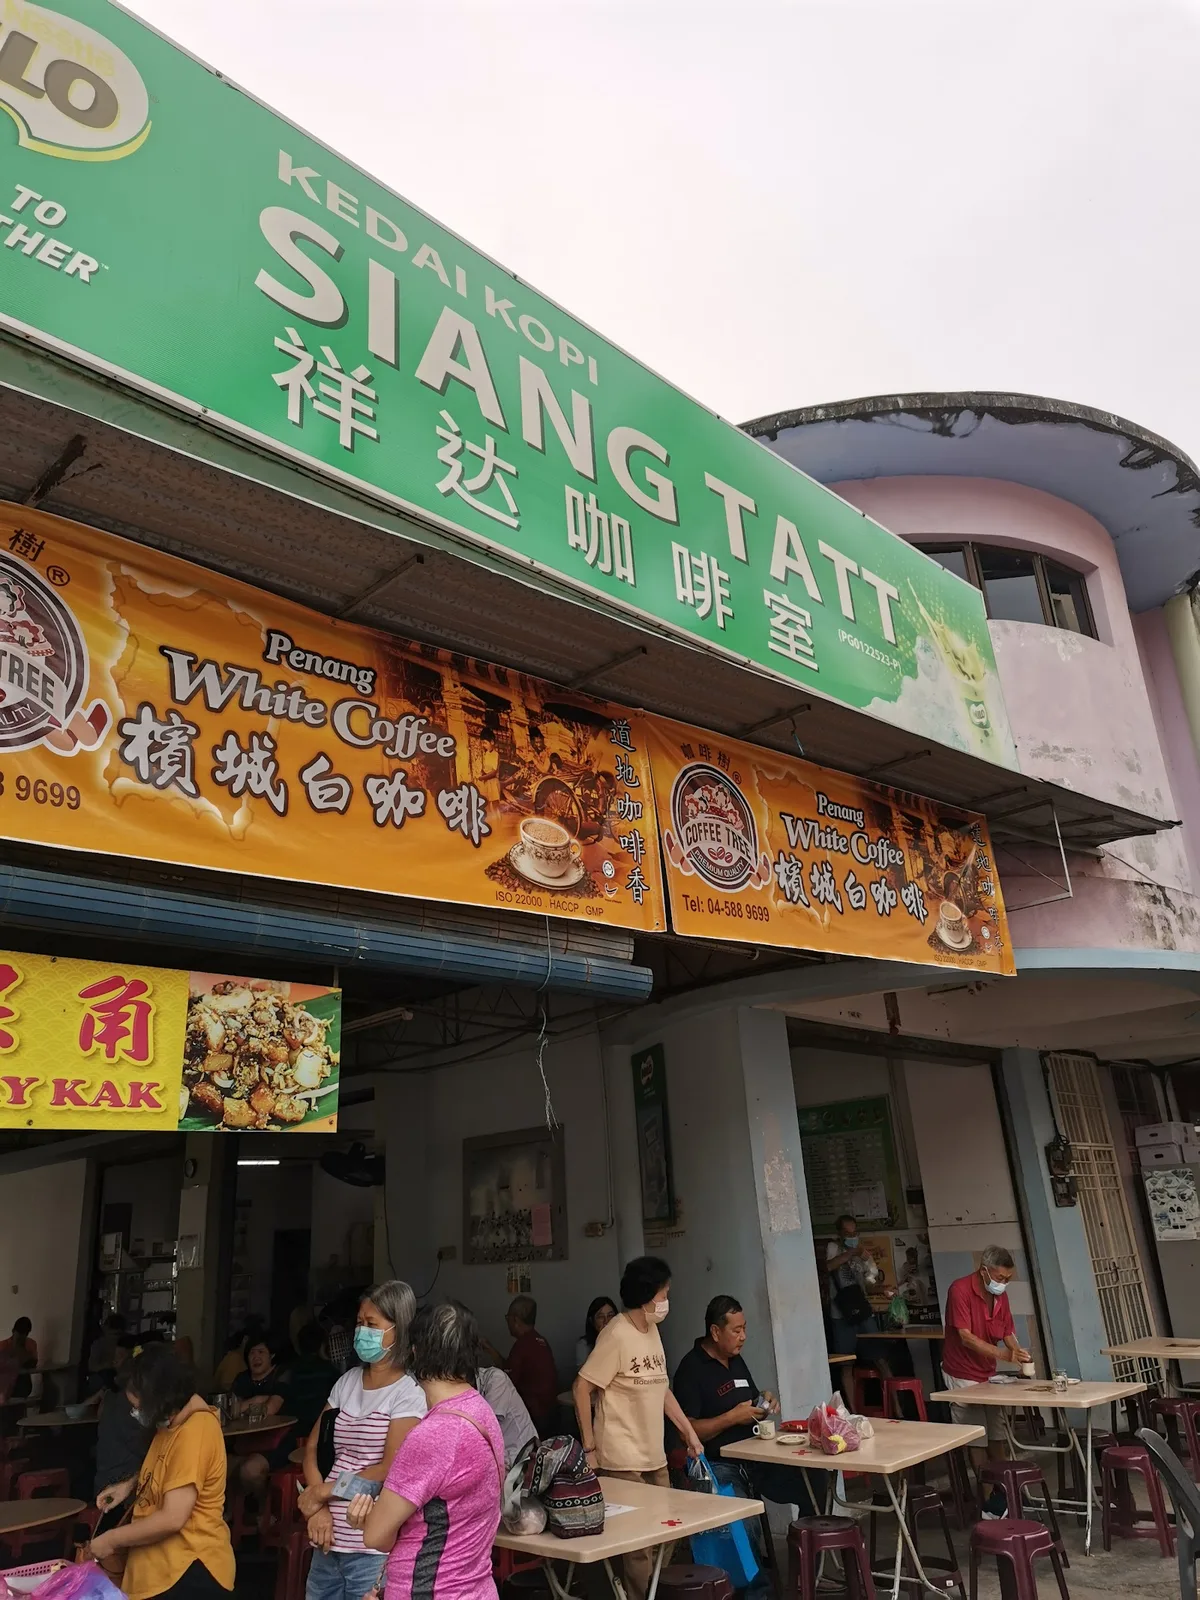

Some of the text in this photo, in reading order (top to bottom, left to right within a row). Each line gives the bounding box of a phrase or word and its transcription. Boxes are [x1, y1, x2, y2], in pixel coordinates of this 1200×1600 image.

[10, 183, 67, 227] TO
[278, 149, 599, 386] KEDAI KOPI
[254, 205, 900, 646] SIANG TATT
[271, 326, 820, 671] 祥达咖啡室
[266, 629, 376, 695] Penang
[160, 646, 457, 760] White Coffee
[15, 774, 81, 810] 9699
[610, 719, 650, 905] 道地咖啡香
[816, 791, 865, 829] Penang
[685, 822, 752, 861] COFFEE TREE
[780, 812, 905, 870] White Coffee
[694, 849, 745, 878] PREMIUM QUALITY
[495, 890, 604, 916] ISO 22000 HACCP GMP
[682, 893, 770, 922] Tel: 04-588 9699
[50, 1078, 162, 1109] KAK
